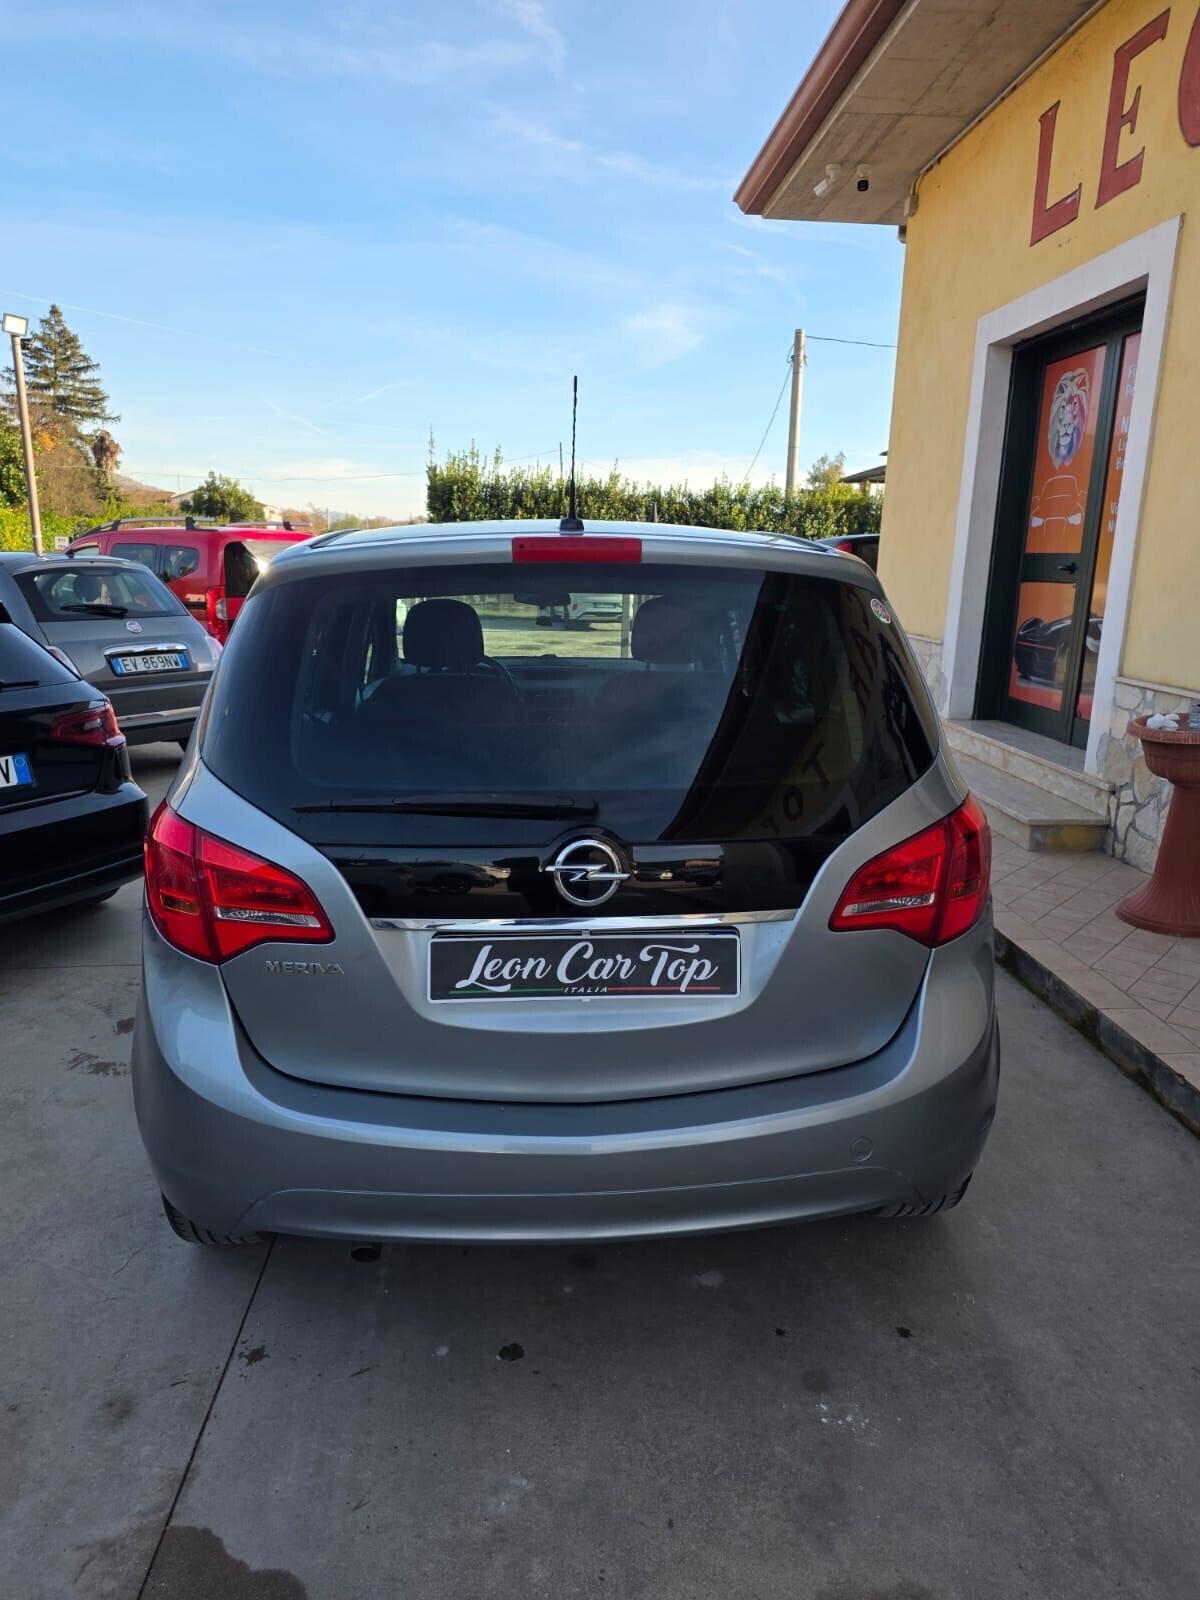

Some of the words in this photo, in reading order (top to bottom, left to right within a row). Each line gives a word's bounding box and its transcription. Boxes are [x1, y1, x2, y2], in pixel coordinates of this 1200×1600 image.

[1030, 6, 1200, 247] LE
[265, 960, 345, 975] MERIVA
[455, 944, 552, 992] Leon
[556, 941, 637, 984] Car
[639, 944, 719, 993] Top
